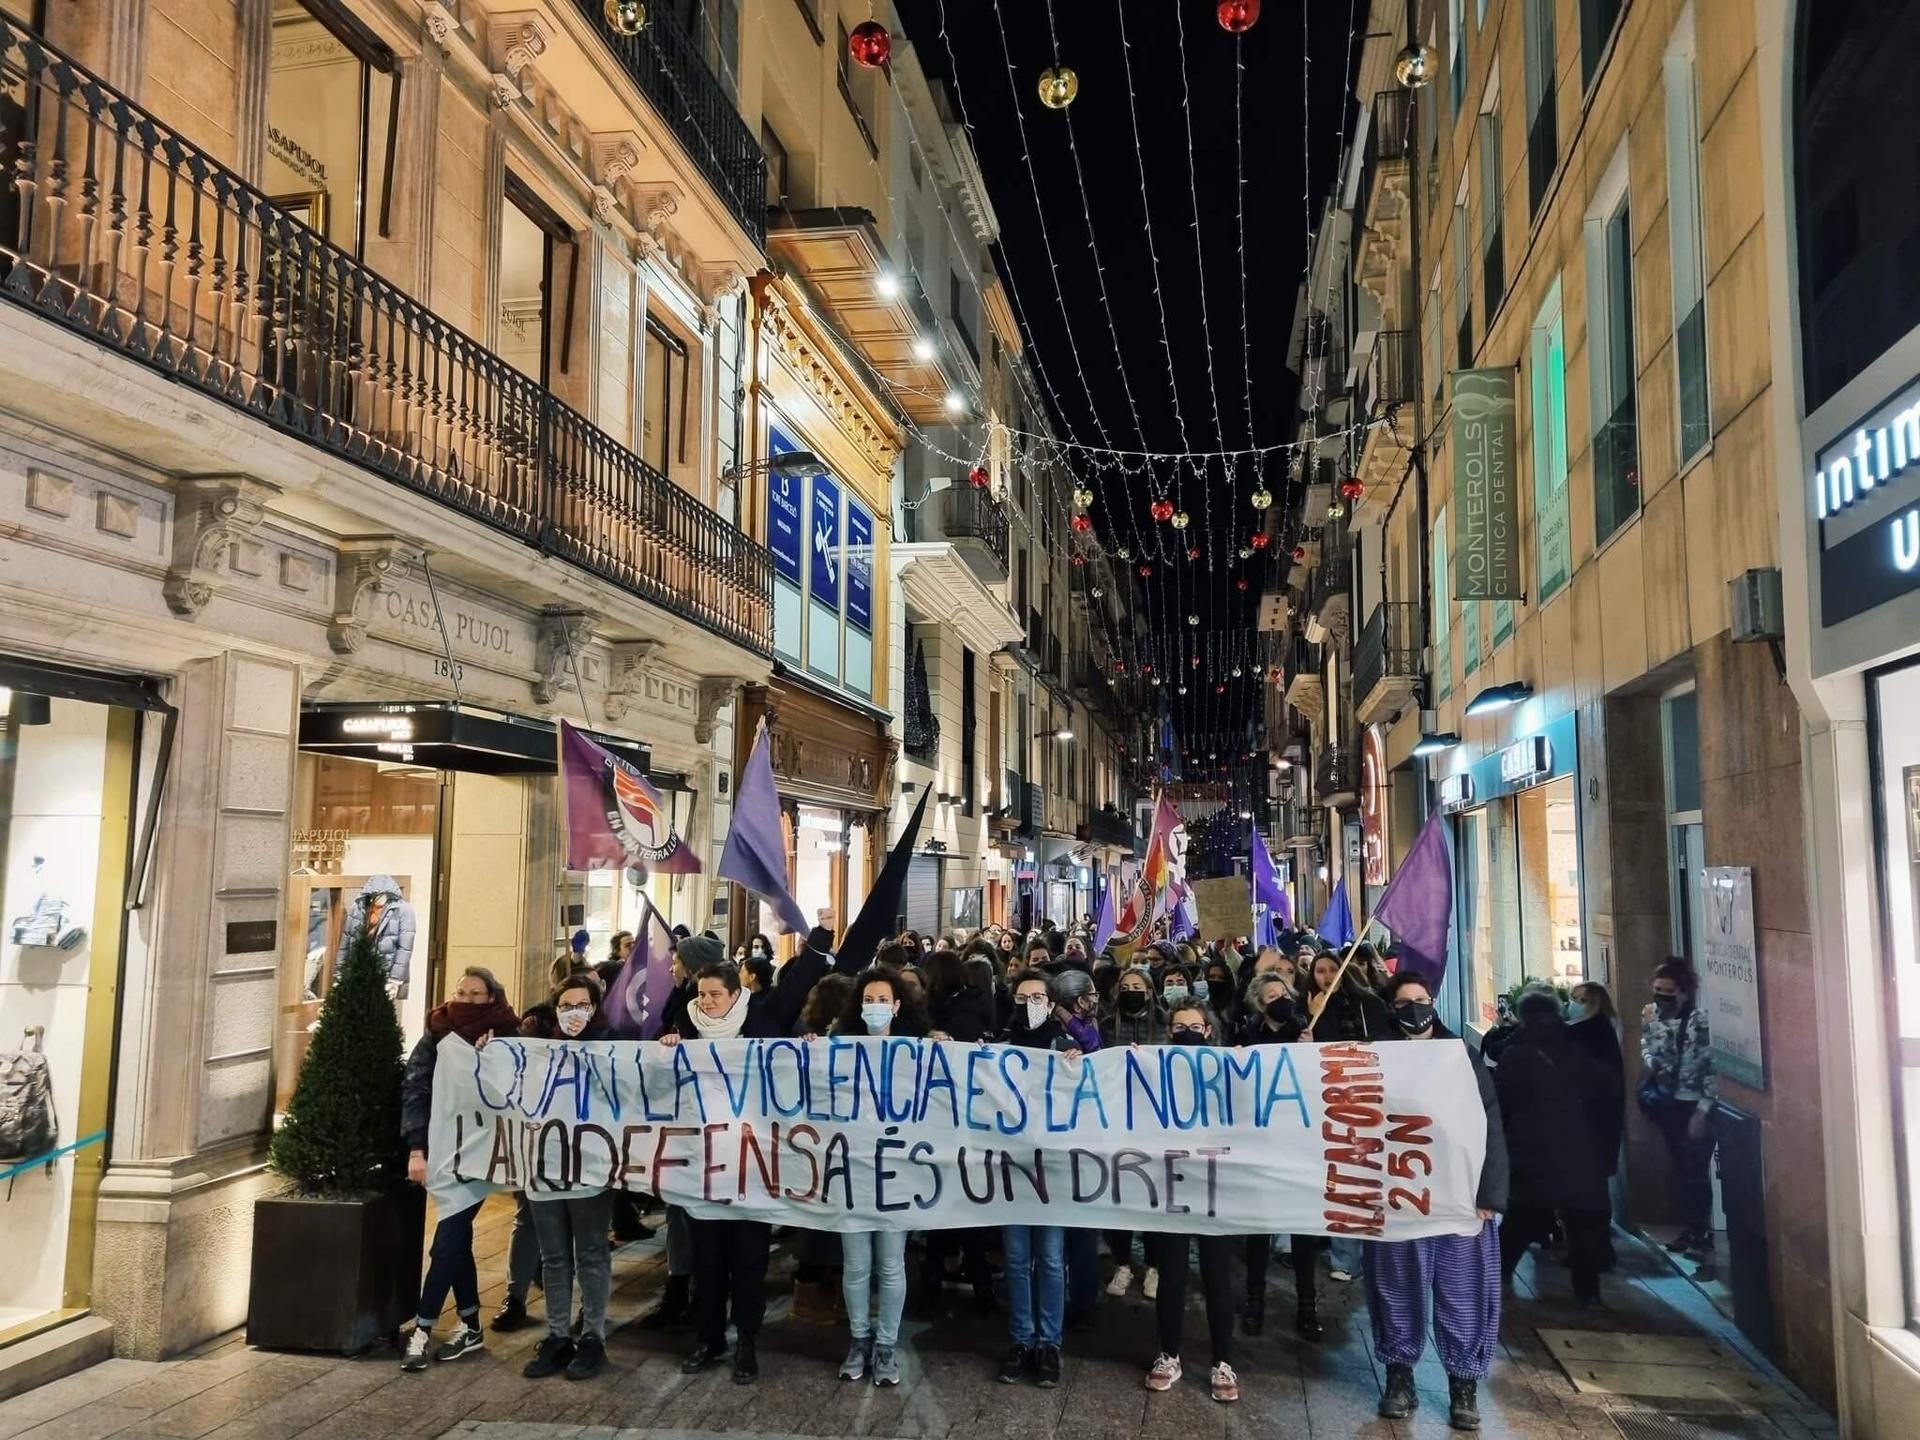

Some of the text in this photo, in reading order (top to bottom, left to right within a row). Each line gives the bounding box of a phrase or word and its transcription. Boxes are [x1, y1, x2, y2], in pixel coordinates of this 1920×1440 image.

[1492, 423, 1506, 503] DENTAL
[1465, 422, 1485, 595] MONTEROLS
[1494, 511, 1507, 595] CLINICA
[386, 590, 513, 654] CASA PUJOL
[640, 847, 670, 861] TERRA
[475, 1039, 621, 1122] QUAN
[635, 1042, 707, 1123] LA
[966, 1043, 1030, 1135] ÉS
[1045, 1054, 1109, 1132] LA
[1125, 1046, 1312, 1130] NORMA
[874, 1126, 943, 1213] ÉS
[957, 1146, 1050, 1205] UN
[1068, 1146, 1231, 1217] DRET
[1384, 1113, 1433, 1216] 25N
